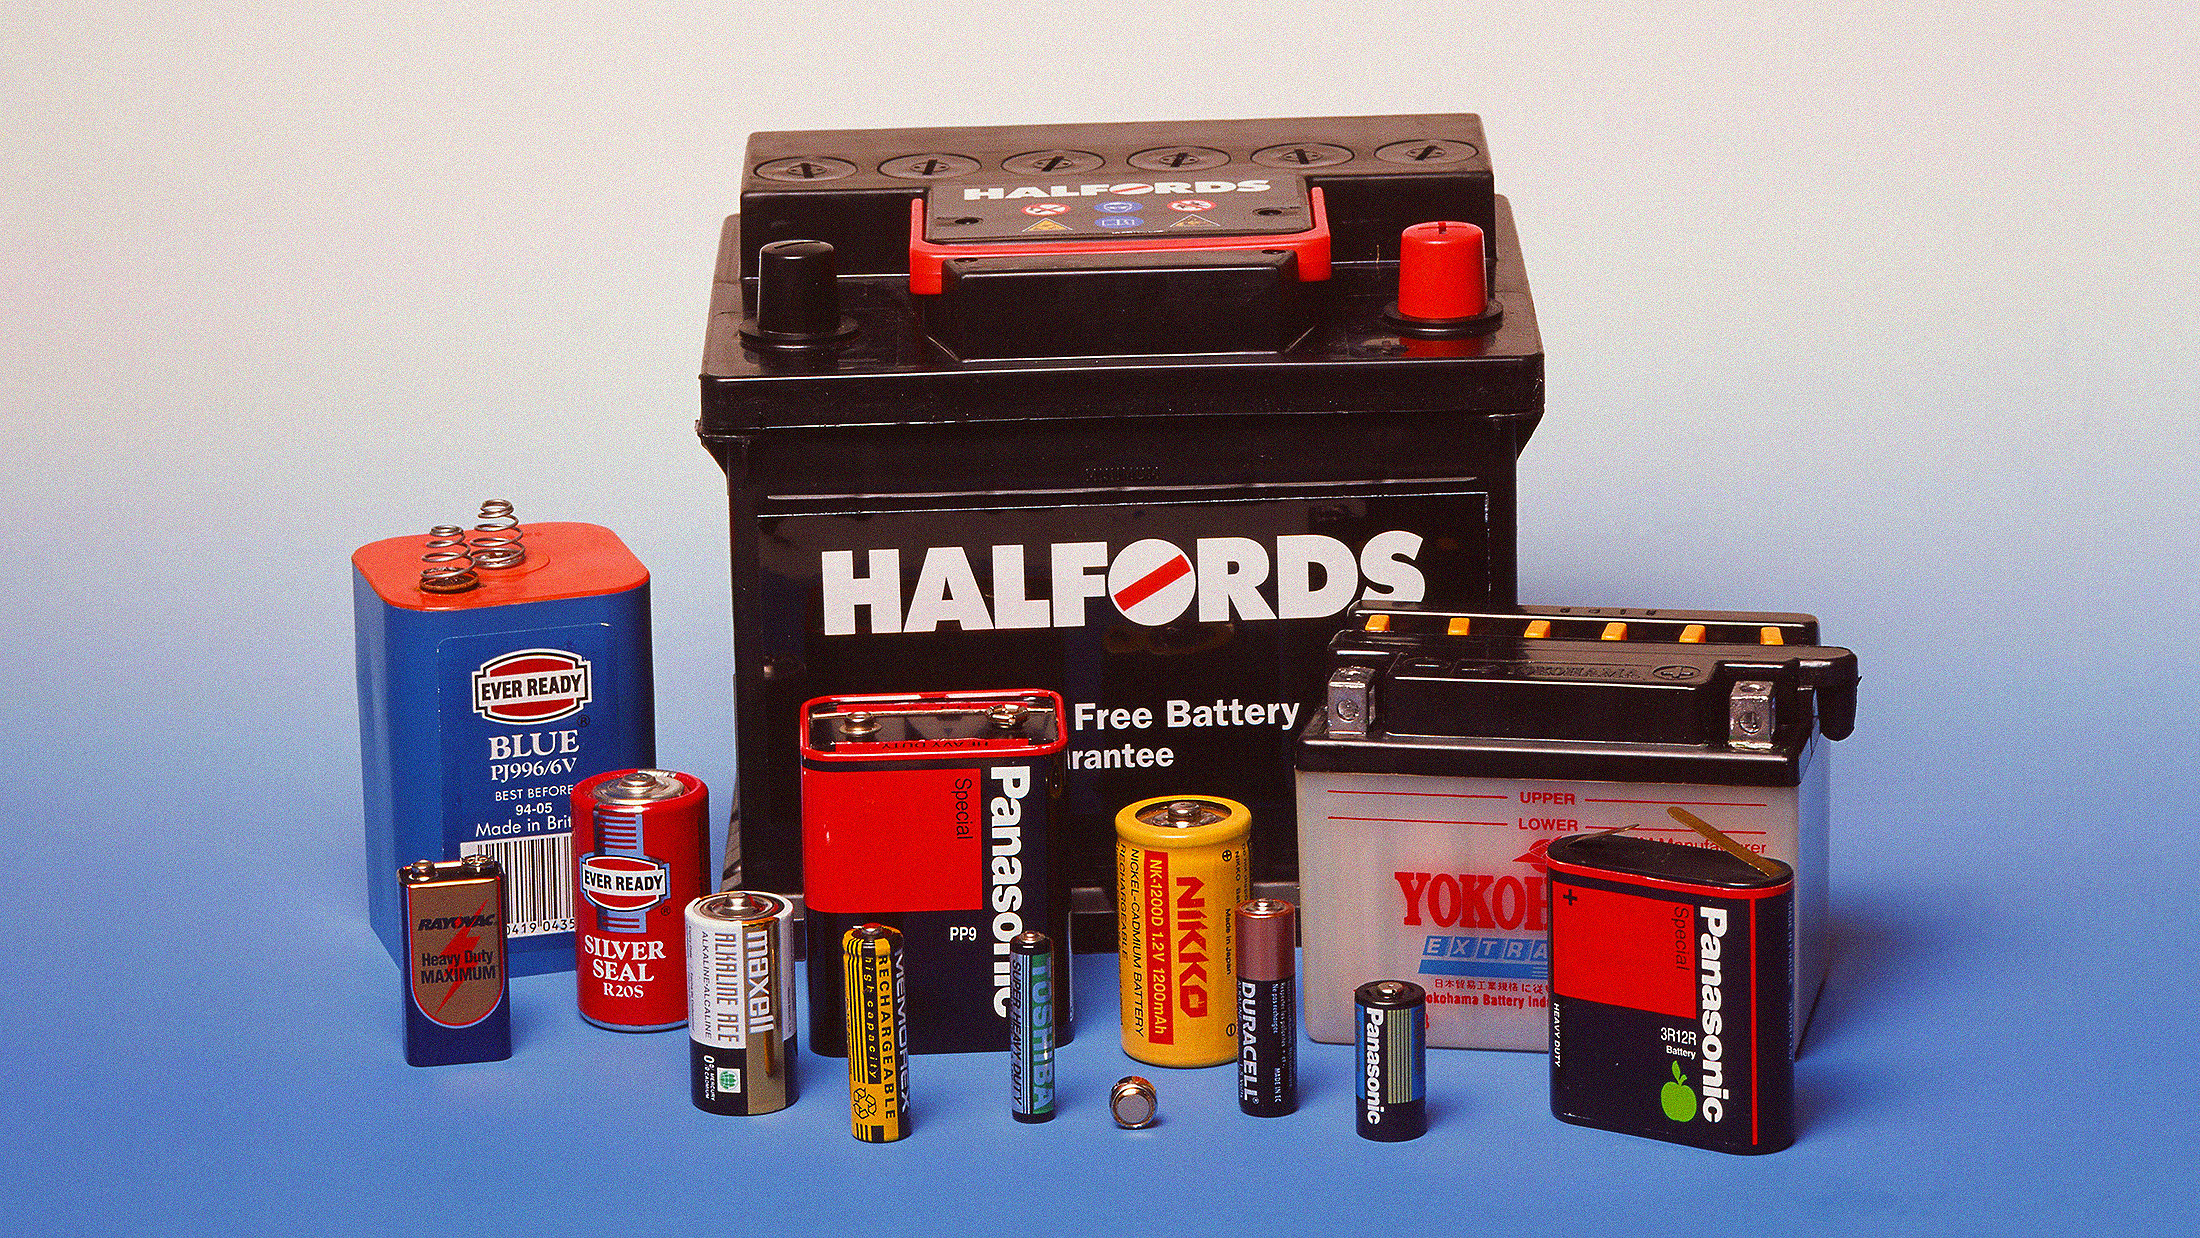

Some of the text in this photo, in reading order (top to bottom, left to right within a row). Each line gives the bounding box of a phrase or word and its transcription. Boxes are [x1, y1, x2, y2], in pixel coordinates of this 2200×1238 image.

[964, 180, 1272, 200] HALFORDS
[821, 530, 1426, 636] HALFORDS
[481, 674, 583, 701] EVER READY
[1074, 698, 1300, 731] Free Battery
[488, 729, 580, 761] BLUE
[1067, 743, 1174, 770] rantee
[491, 757, 578, 783] PJ996/6V
[495, 784, 574, 802] BEST BEFORE
[1519, 791, 1576, 805] UPPER
[515, 802, 553, 816] 94-05
[954, 778, 973, 840] Special
[475, 815, 572, 837] Made in Brit
[1518, 817, 1579, 832] LOWER
[584, 871, 663, 892] EVER READY
[1119, 843, 1128, 960] RECHARGEABLE
[1394, 871, 1548, 931] YOKOH
[418, 913, 495, 931] RAYOVAC
[949, 926, 977, 942] PP9
[584, 936, 667, 961] SILVER
[1130, 848, 1144, 1037] NICKEL-CADMIUM BATTERY
[1150, 859, 1167, 1034] NK-1200D 1.2V 1200mAh
[1175, 876, 1209, 1018] NIKKO
[1426, 936, 1548, 961] EXTRA
[1671, 905, 1690, 971] Special
[421, 949, 493, 967] Heavy Duty
[592, 960, 655, 983] SEAL
[421, 965, 496, 984] MAXIMUM
[715, 932, 739, 1043] ALKALINE ACE
[747, 930, 774, 1034] maxell
[603, 982, 644, 998] R20S
[1425, 992, 1548, 1010] okohama Battery Ind
[863, 956, 878, 1079] high capacity
[1553, 1002, 1561, 1039] HEAVY
[1700, 906, 1729, 1123] Panasonic
[878, 955, 896, 1119] RECHARGEABLE
[894, 948, 910, 1113] MEMOREX
[1013, 960, 1022, 1105] SUPER HEAVY DUTY
[1032, 956, 1053, 1111] TOSHIBA
[1242, 981, 1258, 1101] DURACELL
[1660, 1026, 1697, 1047] 3R12R
[1366, 1006, 1385, 1125] Panasonic
[1666, 1044, 1697, 1060] Battery
[1275, 1086, 1281, 1094] IN
